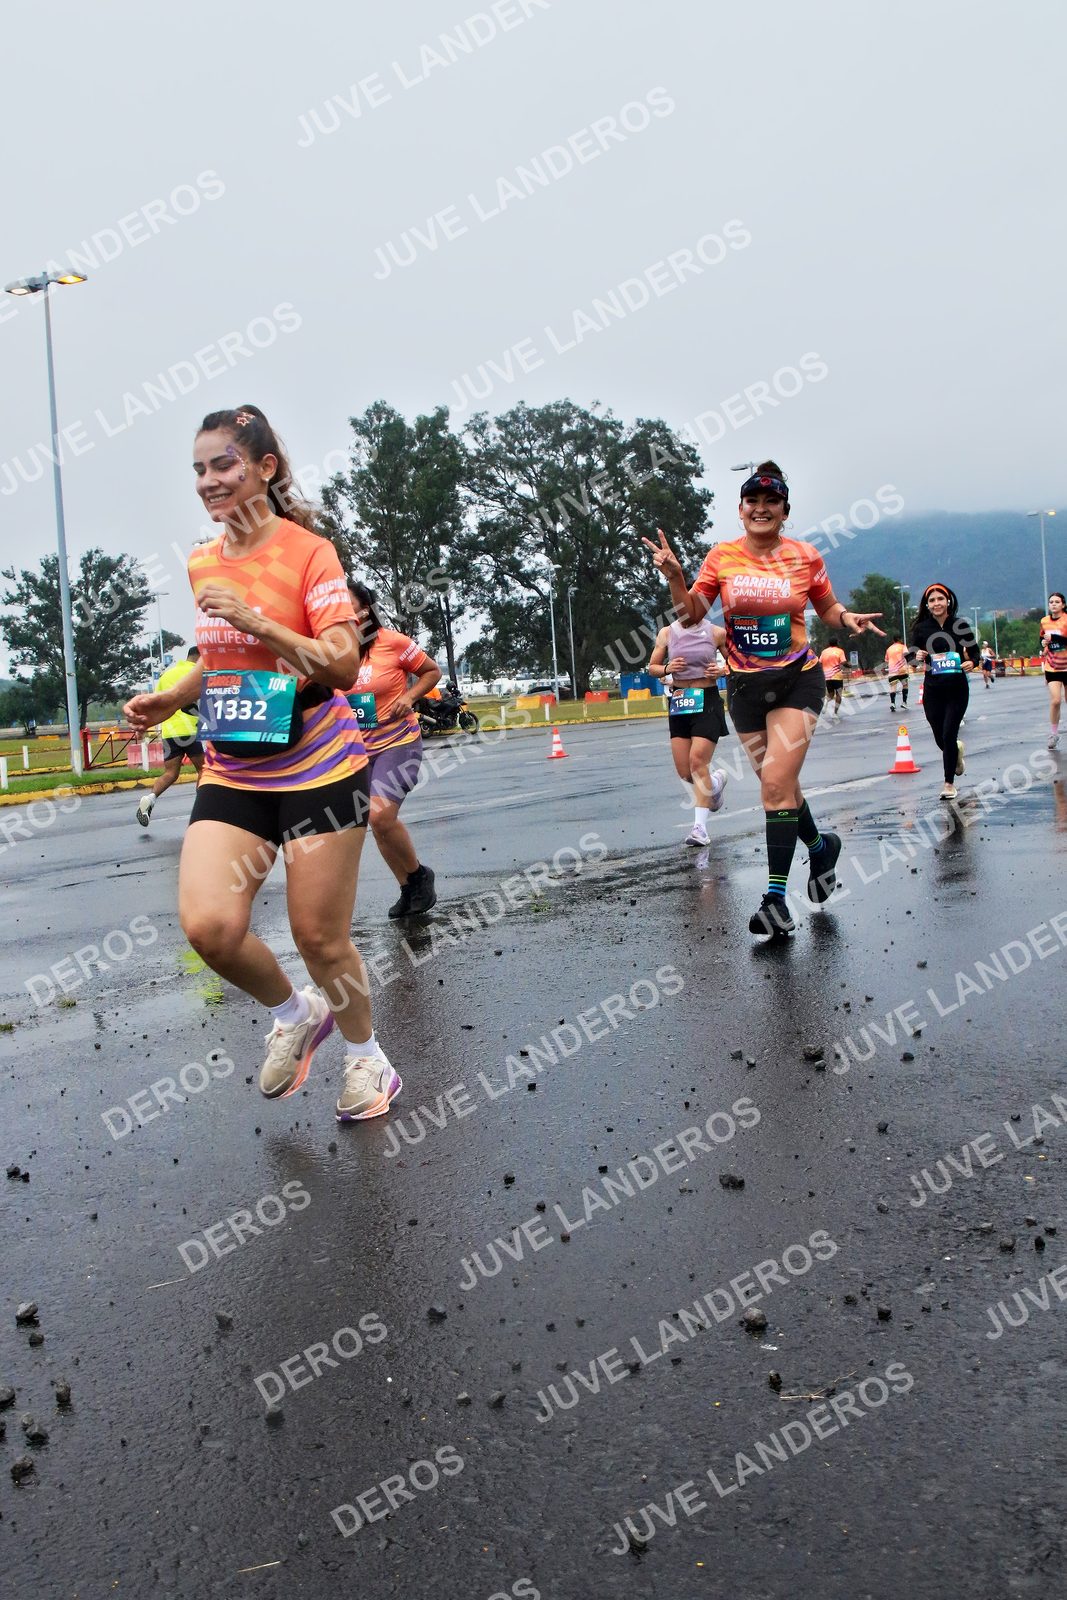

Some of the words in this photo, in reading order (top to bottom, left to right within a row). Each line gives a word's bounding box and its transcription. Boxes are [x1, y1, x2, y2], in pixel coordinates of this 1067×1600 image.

[733, 575, 790, 589] CARRERA
[731, 588, 778, 598] OMNILIFE
[774, 617, 786, 627] 10K
[743, 633, 778, 645] 1563
[937, 660, 956, 668] 1469
[268, 678, 289, 692] 10K
[675, 698, 695, 708] 1589
[213, 700, 268, 720] 1332
